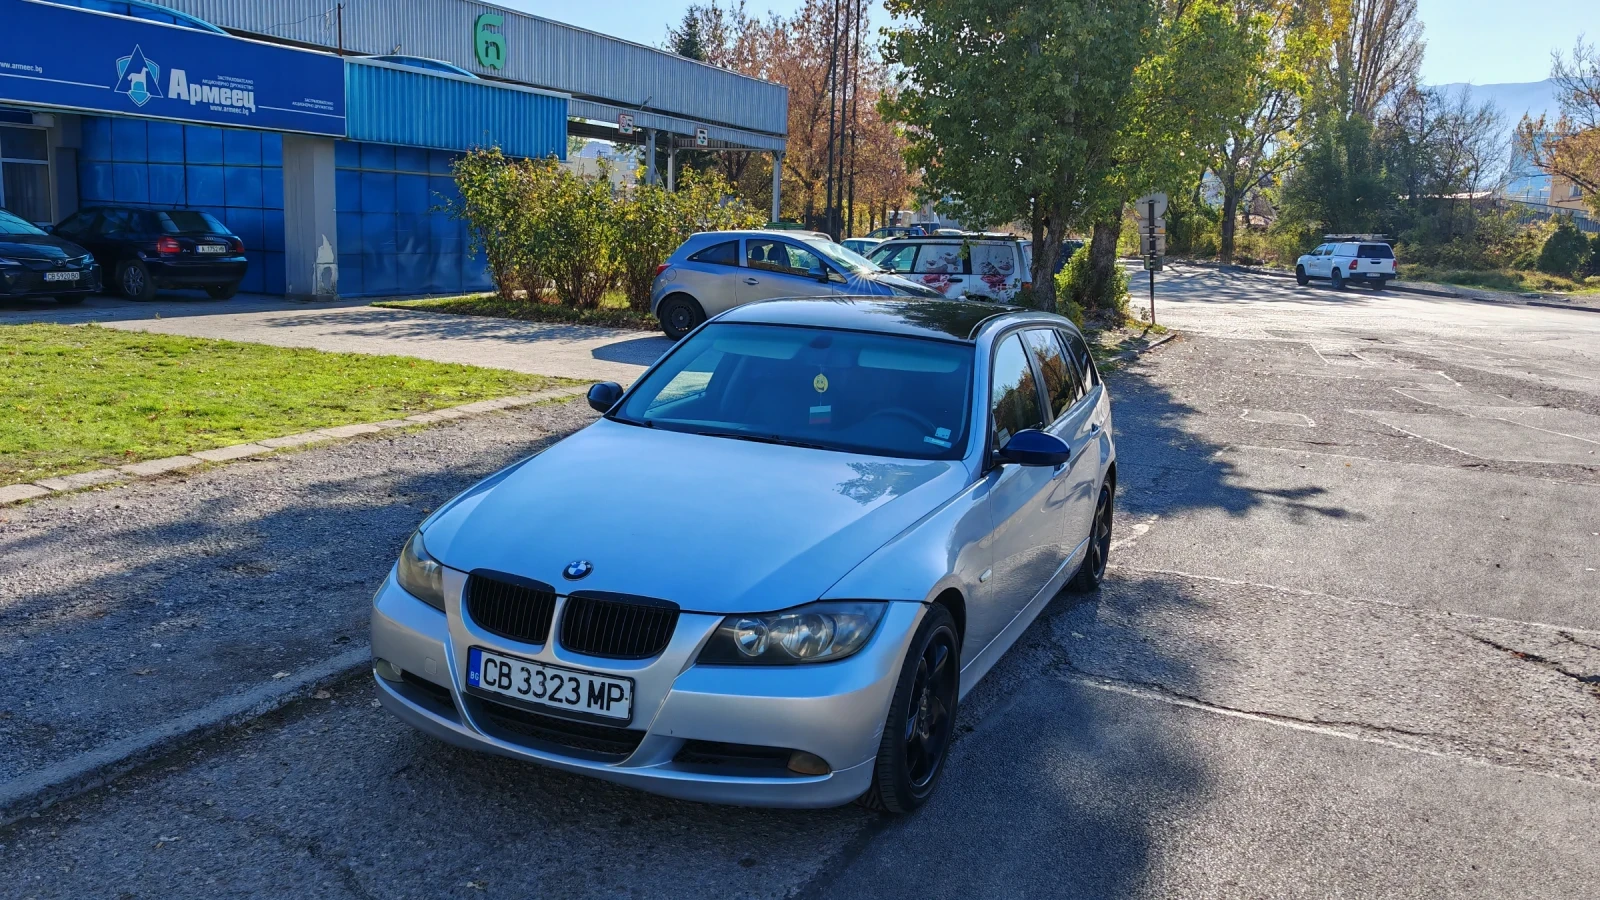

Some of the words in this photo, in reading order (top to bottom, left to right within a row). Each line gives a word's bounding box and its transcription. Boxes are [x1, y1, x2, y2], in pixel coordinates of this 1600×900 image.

[168, 68, 256, 113] Армеец
[209, 104, 249, 116] www.armeec.bg
[470, 671, 480, 681] BG
[483, 658, 513, 691] CB
[517, 666, 581, 705] 3323
[586, 679, 625, 711] MP
